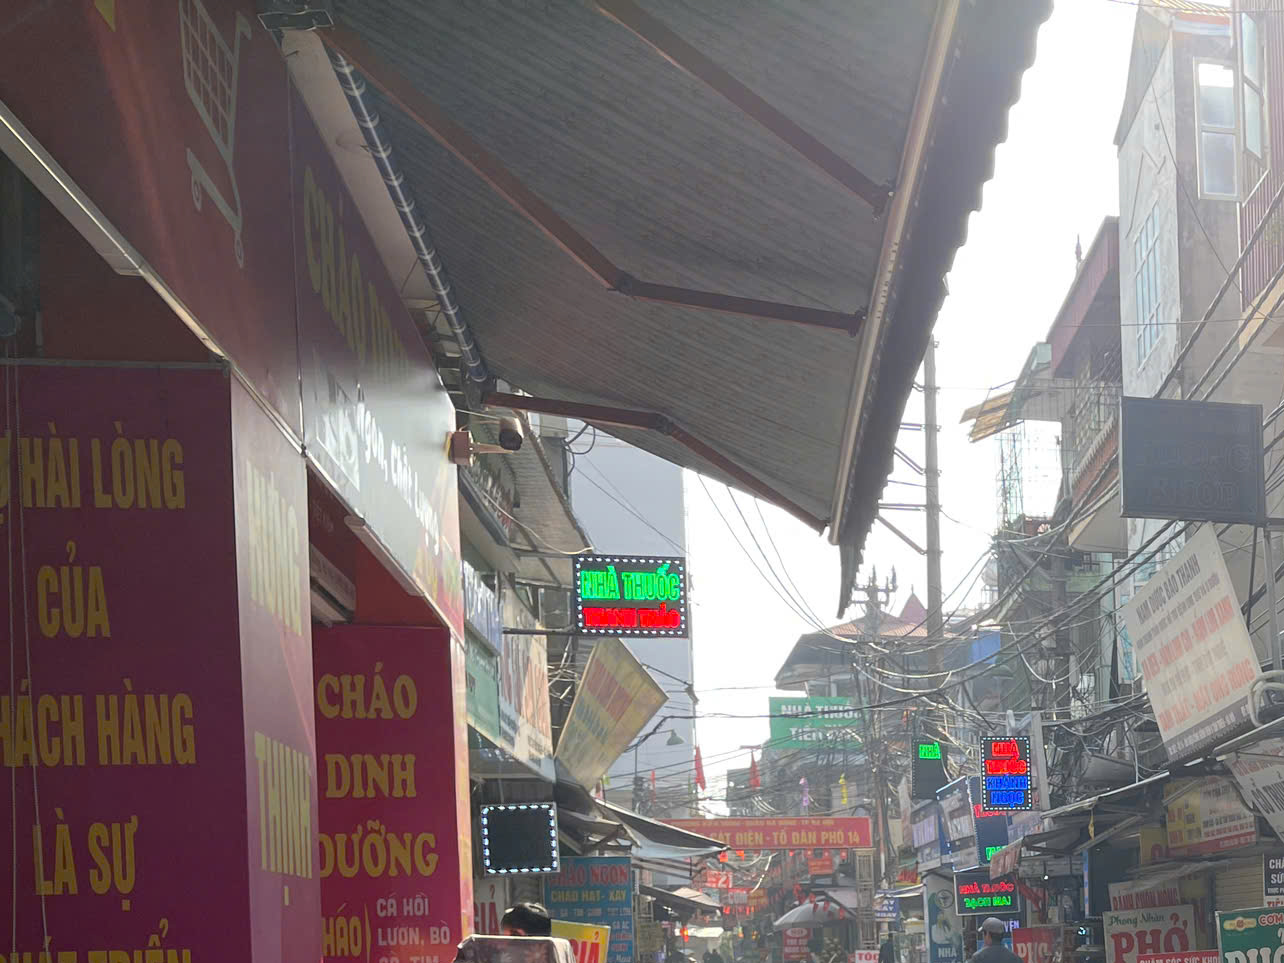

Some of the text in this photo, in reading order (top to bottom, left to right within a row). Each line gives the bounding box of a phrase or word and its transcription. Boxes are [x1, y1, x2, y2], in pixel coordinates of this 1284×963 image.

[21, 420, 186, 509] HÀI LÒNG
[37, 540, 111, 639] CỦA
[580, 563, 681, 600] NHÀ THUỐC
[317, 661, 418, 719] CHÁO
[96, 678, 196, 765] HÀNG
[324, 753, 417, 798] DINH
[986, 773, 1028, 790] KHÁNH
[33, 807, 138, 911] LÀ SỰ
[319, 819, 439, 877] DƯỠNG
[429, 919, 451, 945] BÒ
[1258, 911, 1284, 927] CƠM
